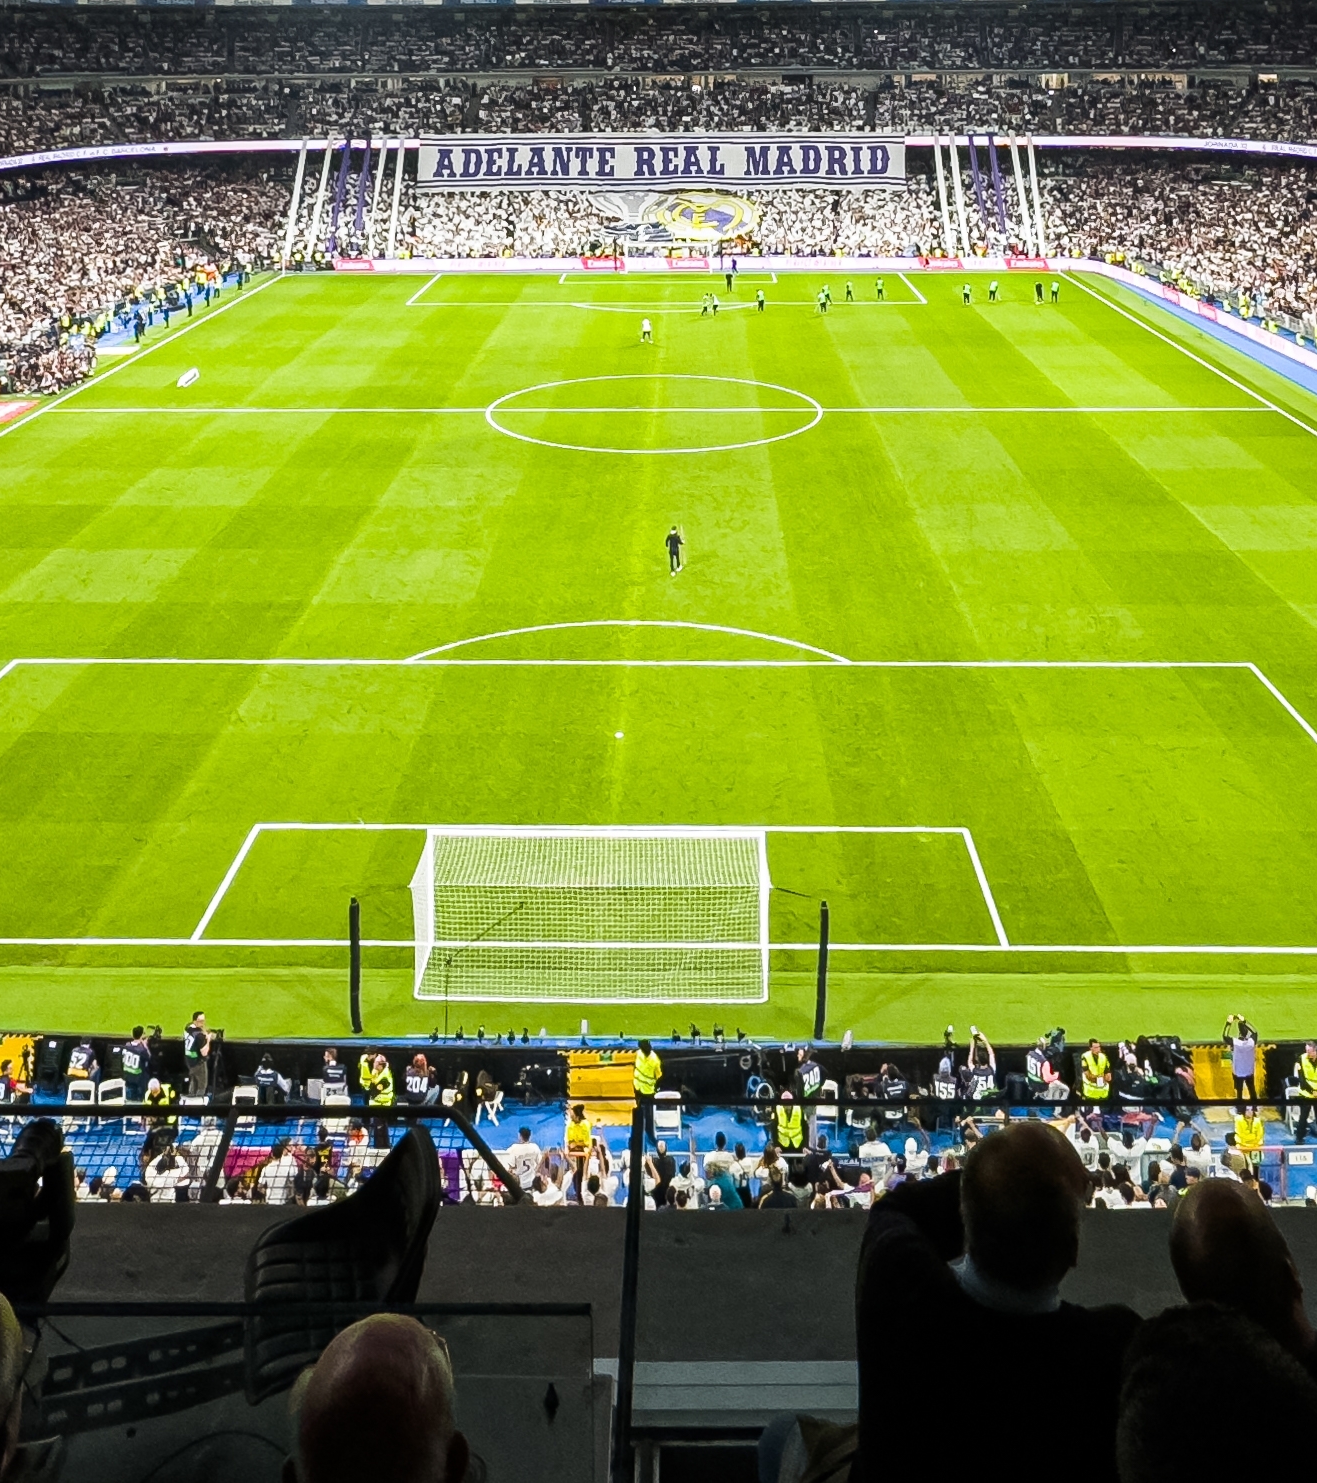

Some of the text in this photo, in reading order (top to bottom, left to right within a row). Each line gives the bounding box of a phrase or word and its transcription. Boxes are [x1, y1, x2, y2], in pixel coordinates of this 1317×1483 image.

[433, 144, 890, 178] ADELANTE REAL MADRID
[406, 1076, 428, 1093] 204
